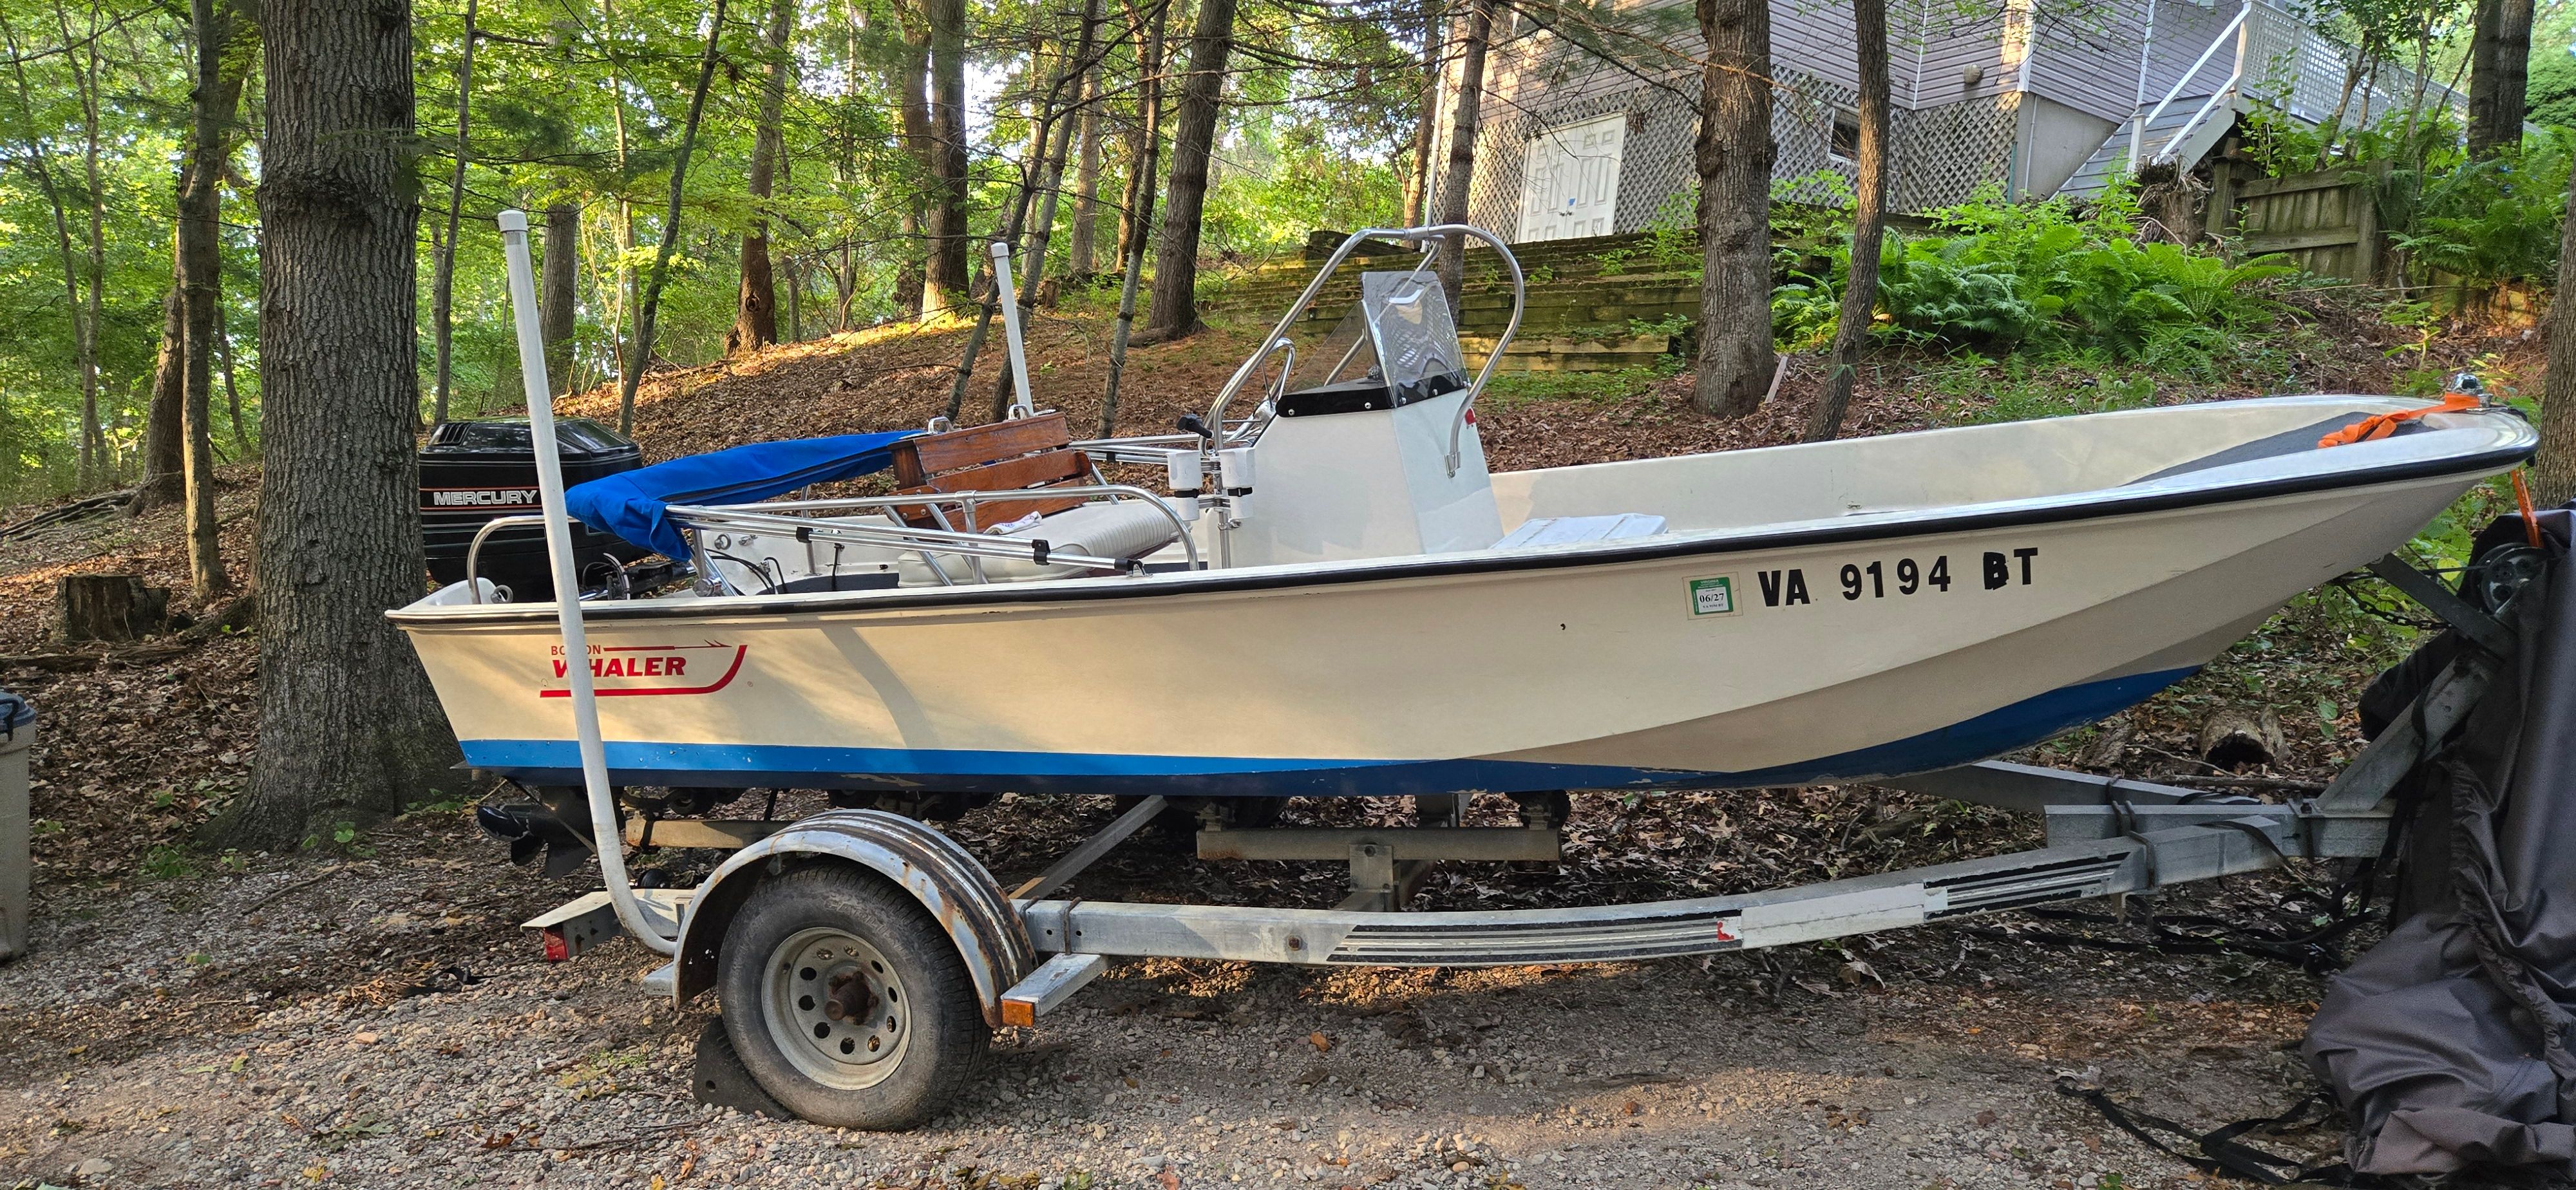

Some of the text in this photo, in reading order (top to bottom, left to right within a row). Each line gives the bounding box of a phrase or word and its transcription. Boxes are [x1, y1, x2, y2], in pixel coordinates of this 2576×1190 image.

[433, 490, 537, 505] MERCURY
[1757, 547, 2038, 607] VA 9194 BT
[1700, 592, 1724, 603] 06/27
[551, 645, 601, 656] BOON
